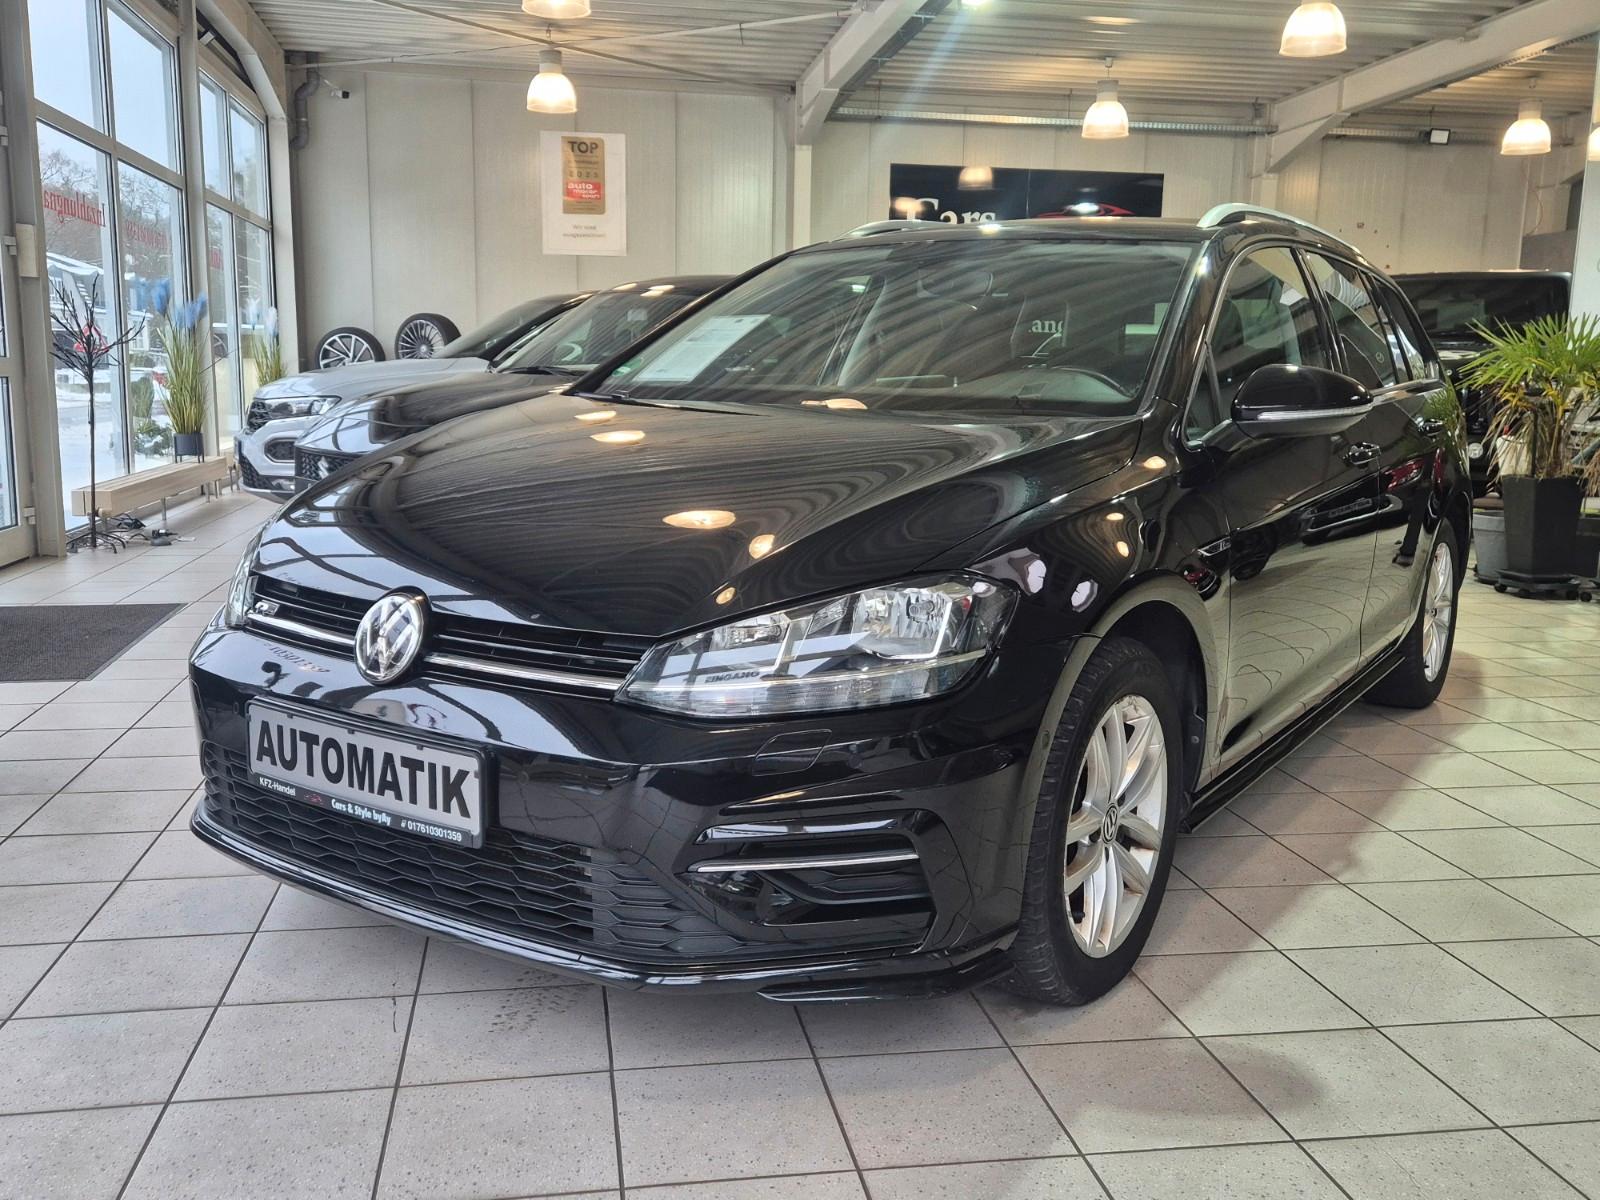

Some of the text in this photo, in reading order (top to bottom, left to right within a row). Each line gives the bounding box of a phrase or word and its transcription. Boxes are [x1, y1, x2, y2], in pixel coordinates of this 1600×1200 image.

[567, 141, 599, 153] TOP
[567, 182, 593, 190] auto
[255, 719, 472, 819] AUTOMATIK
[259, 776, 297, 797] KFZ-Handel
[331, 798, 347, 812] Cars
[347, 803, 354, 814] &
[354, 805, 372, 820] Style
[407, 820, 463, 842] 017610301359
